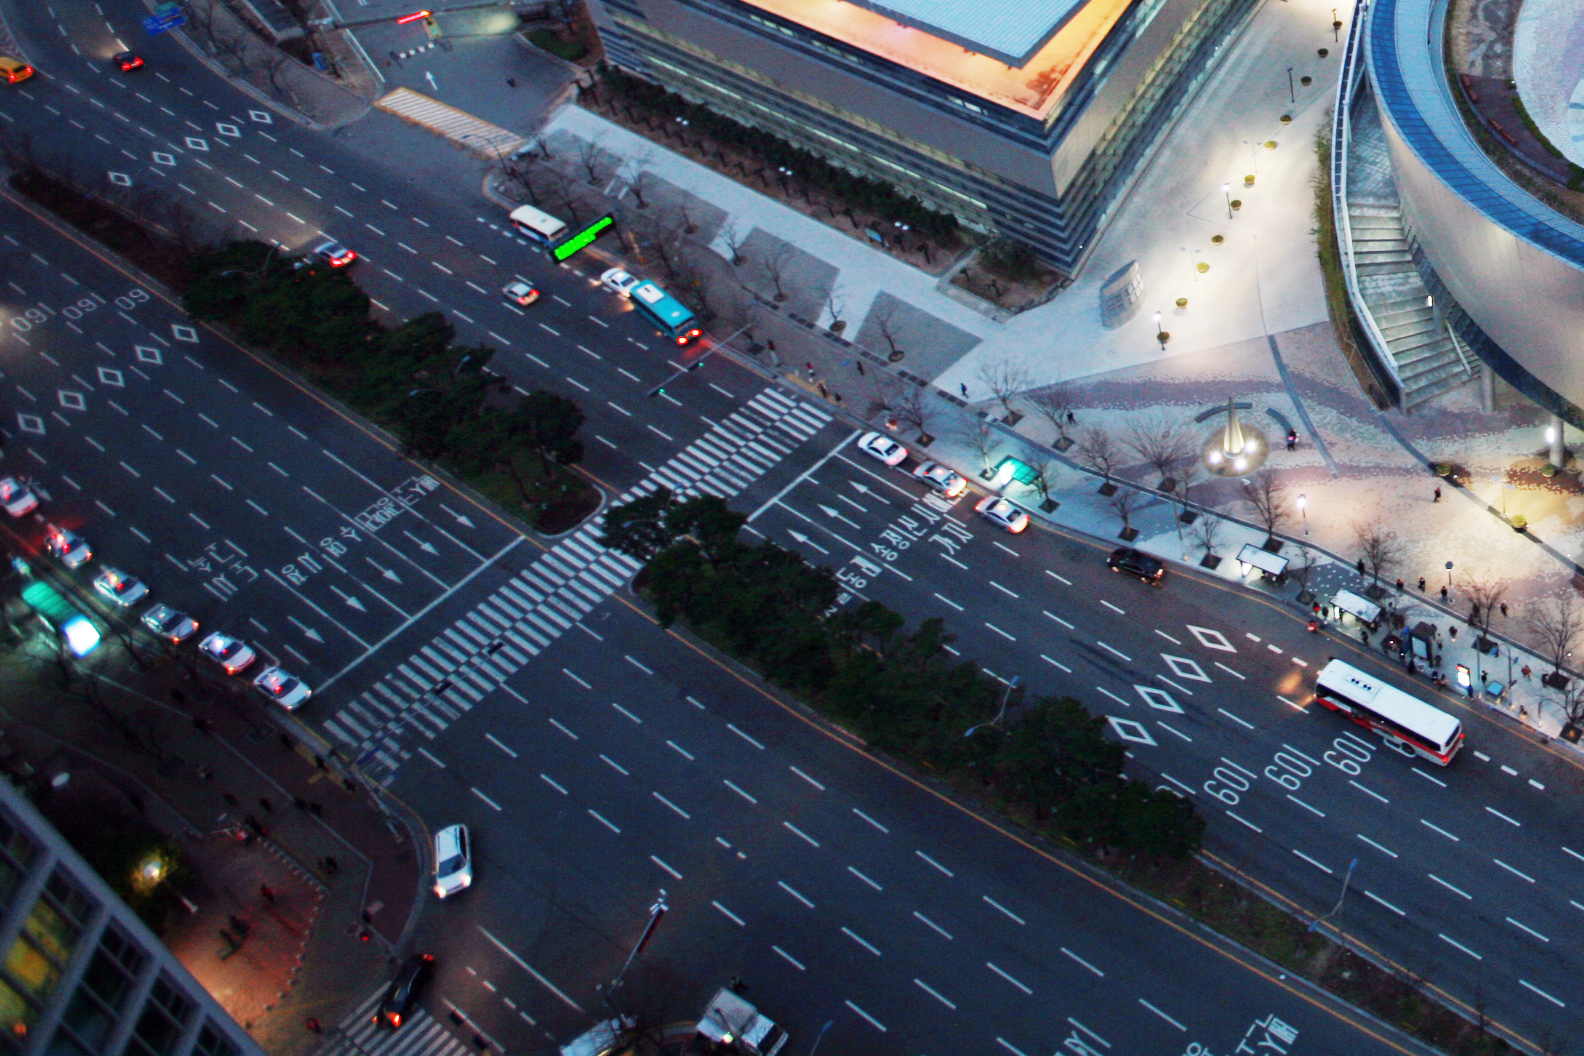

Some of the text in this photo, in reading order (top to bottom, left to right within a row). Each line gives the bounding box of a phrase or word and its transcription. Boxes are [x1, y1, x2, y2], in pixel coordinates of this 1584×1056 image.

[62, 298, 98, 320] 60
[114, 288, 150, 310] 60
[10, 308, 47, 332] 60
[1264, 752, 1312, 791] 60
[1323, 737, 1372, 776] 60
[1203, 767, 1250, 805] 60
